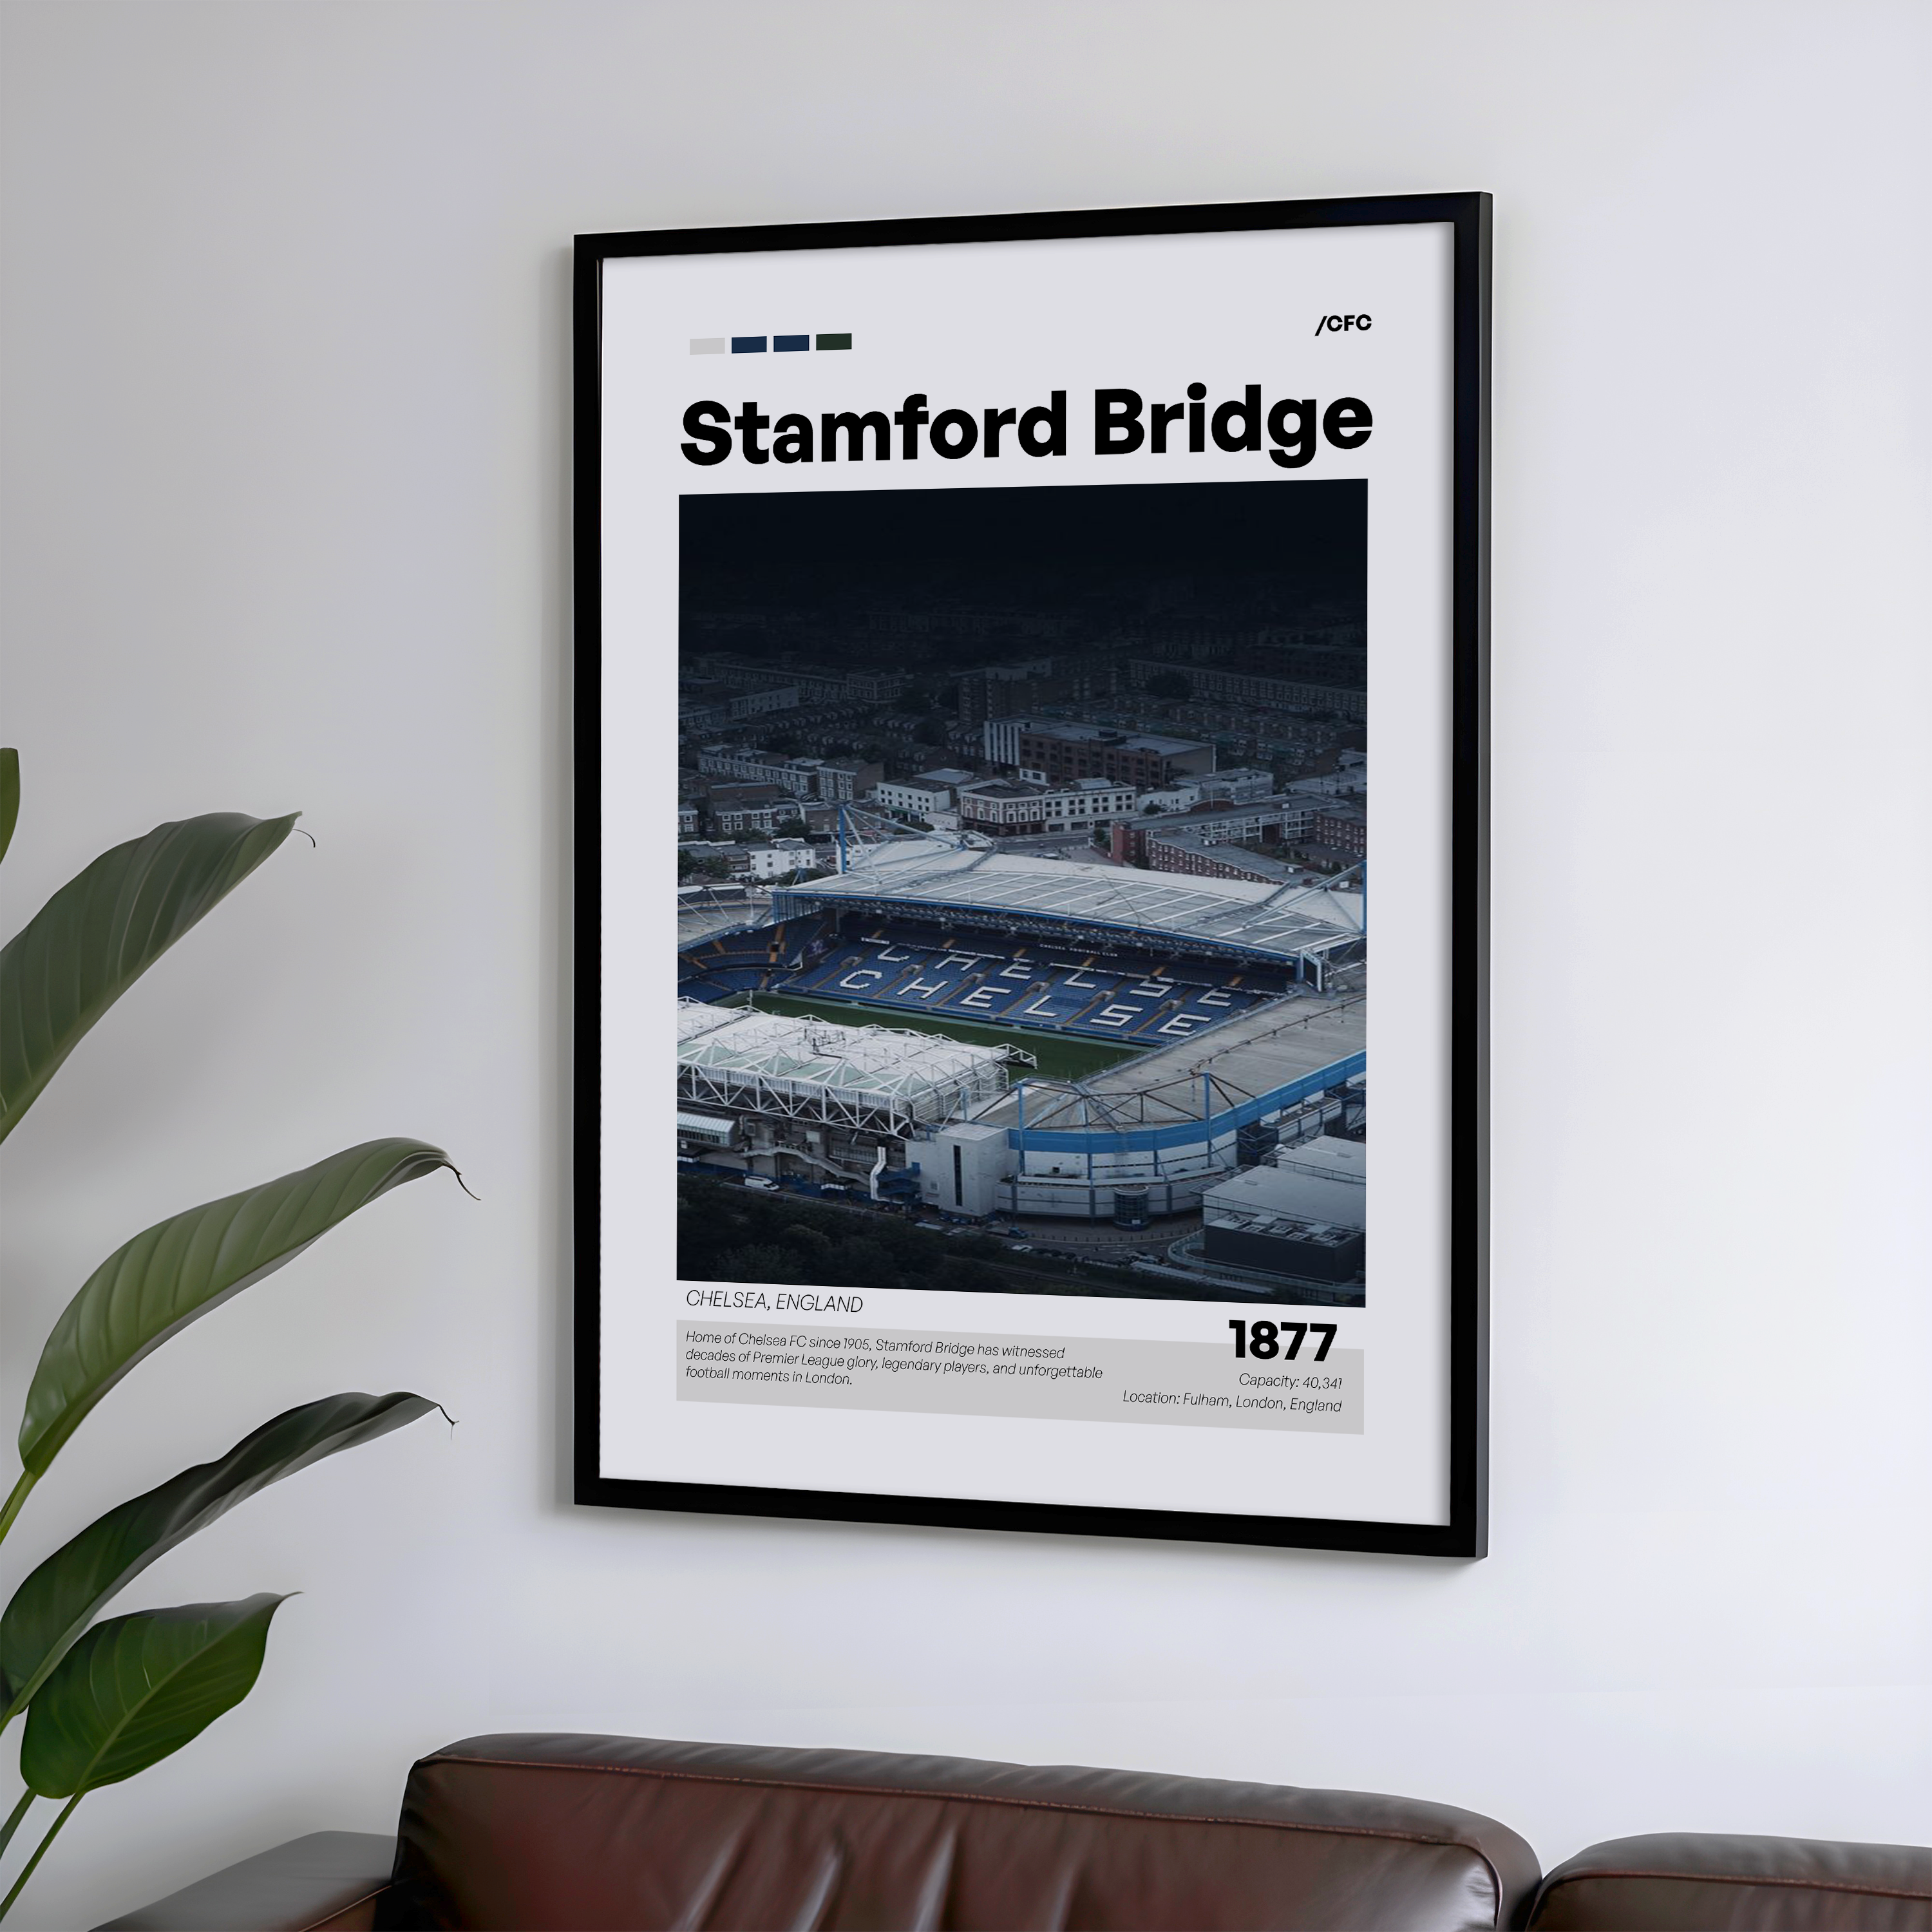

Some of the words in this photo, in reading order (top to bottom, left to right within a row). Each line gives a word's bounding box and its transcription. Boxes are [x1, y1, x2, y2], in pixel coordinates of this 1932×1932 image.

[1314, 314, 1372, 337] /CFC
[680, 388, 1066, 466] Stamford
[1094, 382, 1373, 469] Bridge
[687, 1289, 771, 1311] CHELSEA,
[776, 1293, 863, 1312] ENGLAND
[686, 1331, 722, 1344] Home
[724, 1332, 737, 1345] of
[738, 1333, 787, 1347] Chelsea
[789, 1335, 808, 1348] FC
[808, 1336, 841, 1349] since
[844, 1338, 872, 1352] 1905,
[875, 1338, 933, 1353] Stamford
[934, 1341, 975, 1358] Bridge
[977, 1343, 999, 1356] has
[1002, 1345, 1066, 1359] witnessed
[1229, 1320, 1338, 1362] 1877
[685, 1348, 736, 1362] decades
[738, 1350, 752, 1363] of
[752, 1351, 800, 1365] Premier
[801, 1353, 845, 1369] League
[846, 1356, 878, 1371] glory,
[882, 1357, 942, 1374] legendary
[943, 1360, 989, 1376] players,
[992, 1363, 1017, 1375] and
[1019, 1363, 1103, 1380] unforgettable
[686, 1365, 730, 1379] football
[732, 1370, 790, 1382] moments
[792, 1370, 802, 1383] in
[805, 1371, 853, 1385] London.
[1238, 1372, 1300, 1390] Capacity:
[1302, 1376, 1342, 1390] 40,341
[1122, 1390, 1180, 1405] Location:
[1183, 1392, 1232, 1408] Fulham,
[1236, 1395, 1286, 1411] London,
[1289, 1397, 1342, 1414] England
